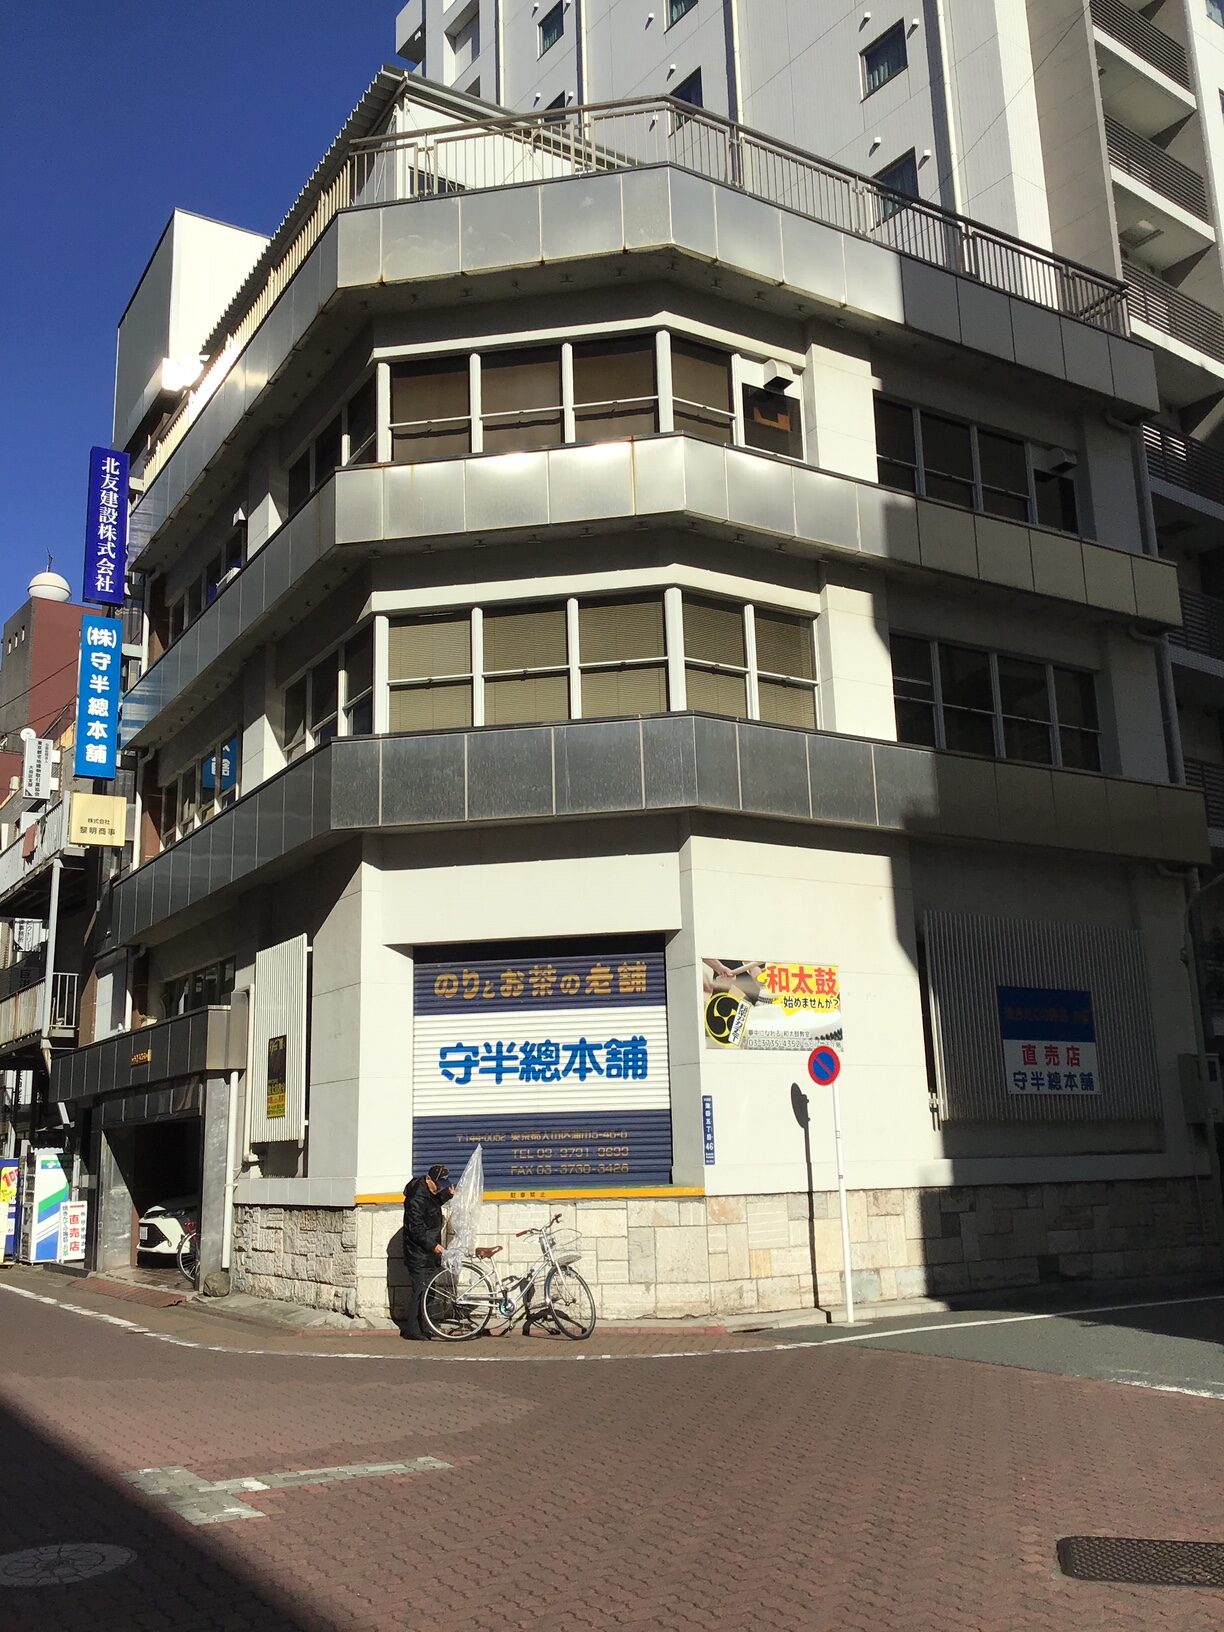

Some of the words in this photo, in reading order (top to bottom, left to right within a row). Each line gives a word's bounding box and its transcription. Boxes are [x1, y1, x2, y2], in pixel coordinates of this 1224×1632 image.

[94, 456, 121, 594] 北友建設株式会社
[87, 817, 111, 825] 株式会社
[433, 961, 648, 1000] のりとお茶の老舗
[766, 964, 838, 996] 和太鼓
[438, 1035, 648, 1085] 守半總本舗
[1021, 1043, 1081, 1067] 直売店
[511, 1164, 533, 1175] FAX
[512, 1148, 534, 1159] TEL
[69, 1214, 80, 1252] 直売店
